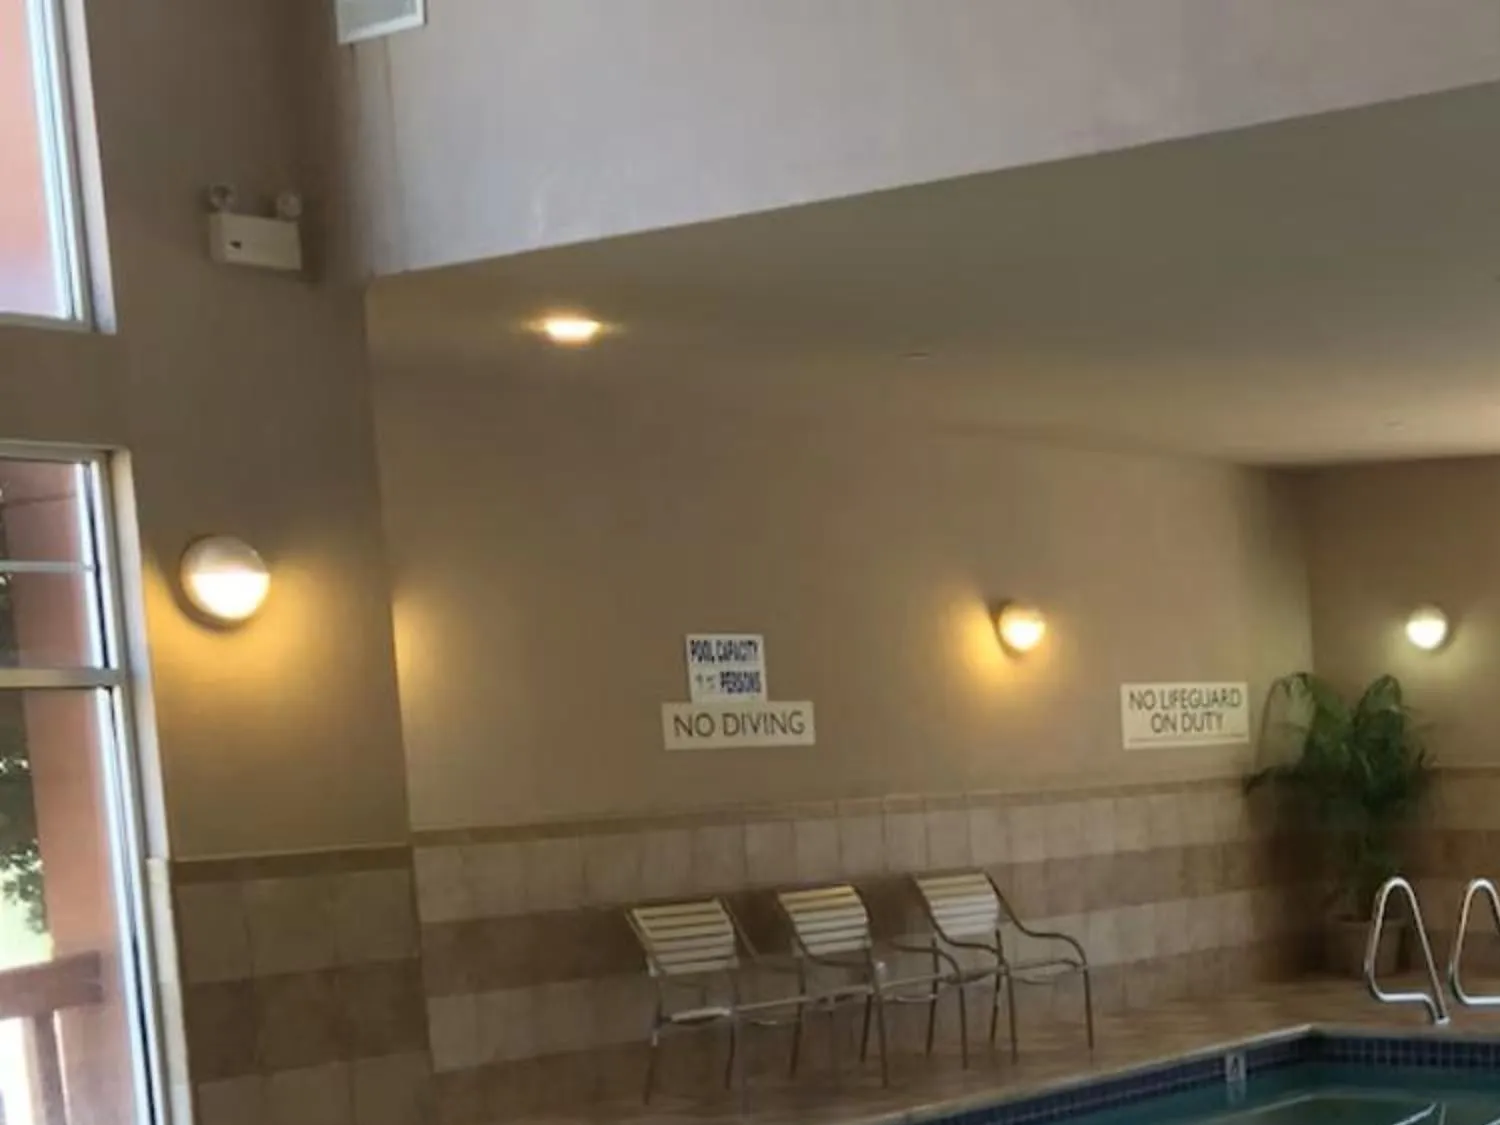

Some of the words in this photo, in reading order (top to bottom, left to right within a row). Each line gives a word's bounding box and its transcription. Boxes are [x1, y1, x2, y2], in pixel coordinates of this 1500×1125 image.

[1129, 689, 1156, 710] NO
[1160, 687, 1243, 710] LIFEGUARD
[673, 712, 715, 737] NO
[722, 710, 805, 736] DIVING
[1151, 712, 1177, 733] ON
[1181, 711, 1223, 732] DUTY
